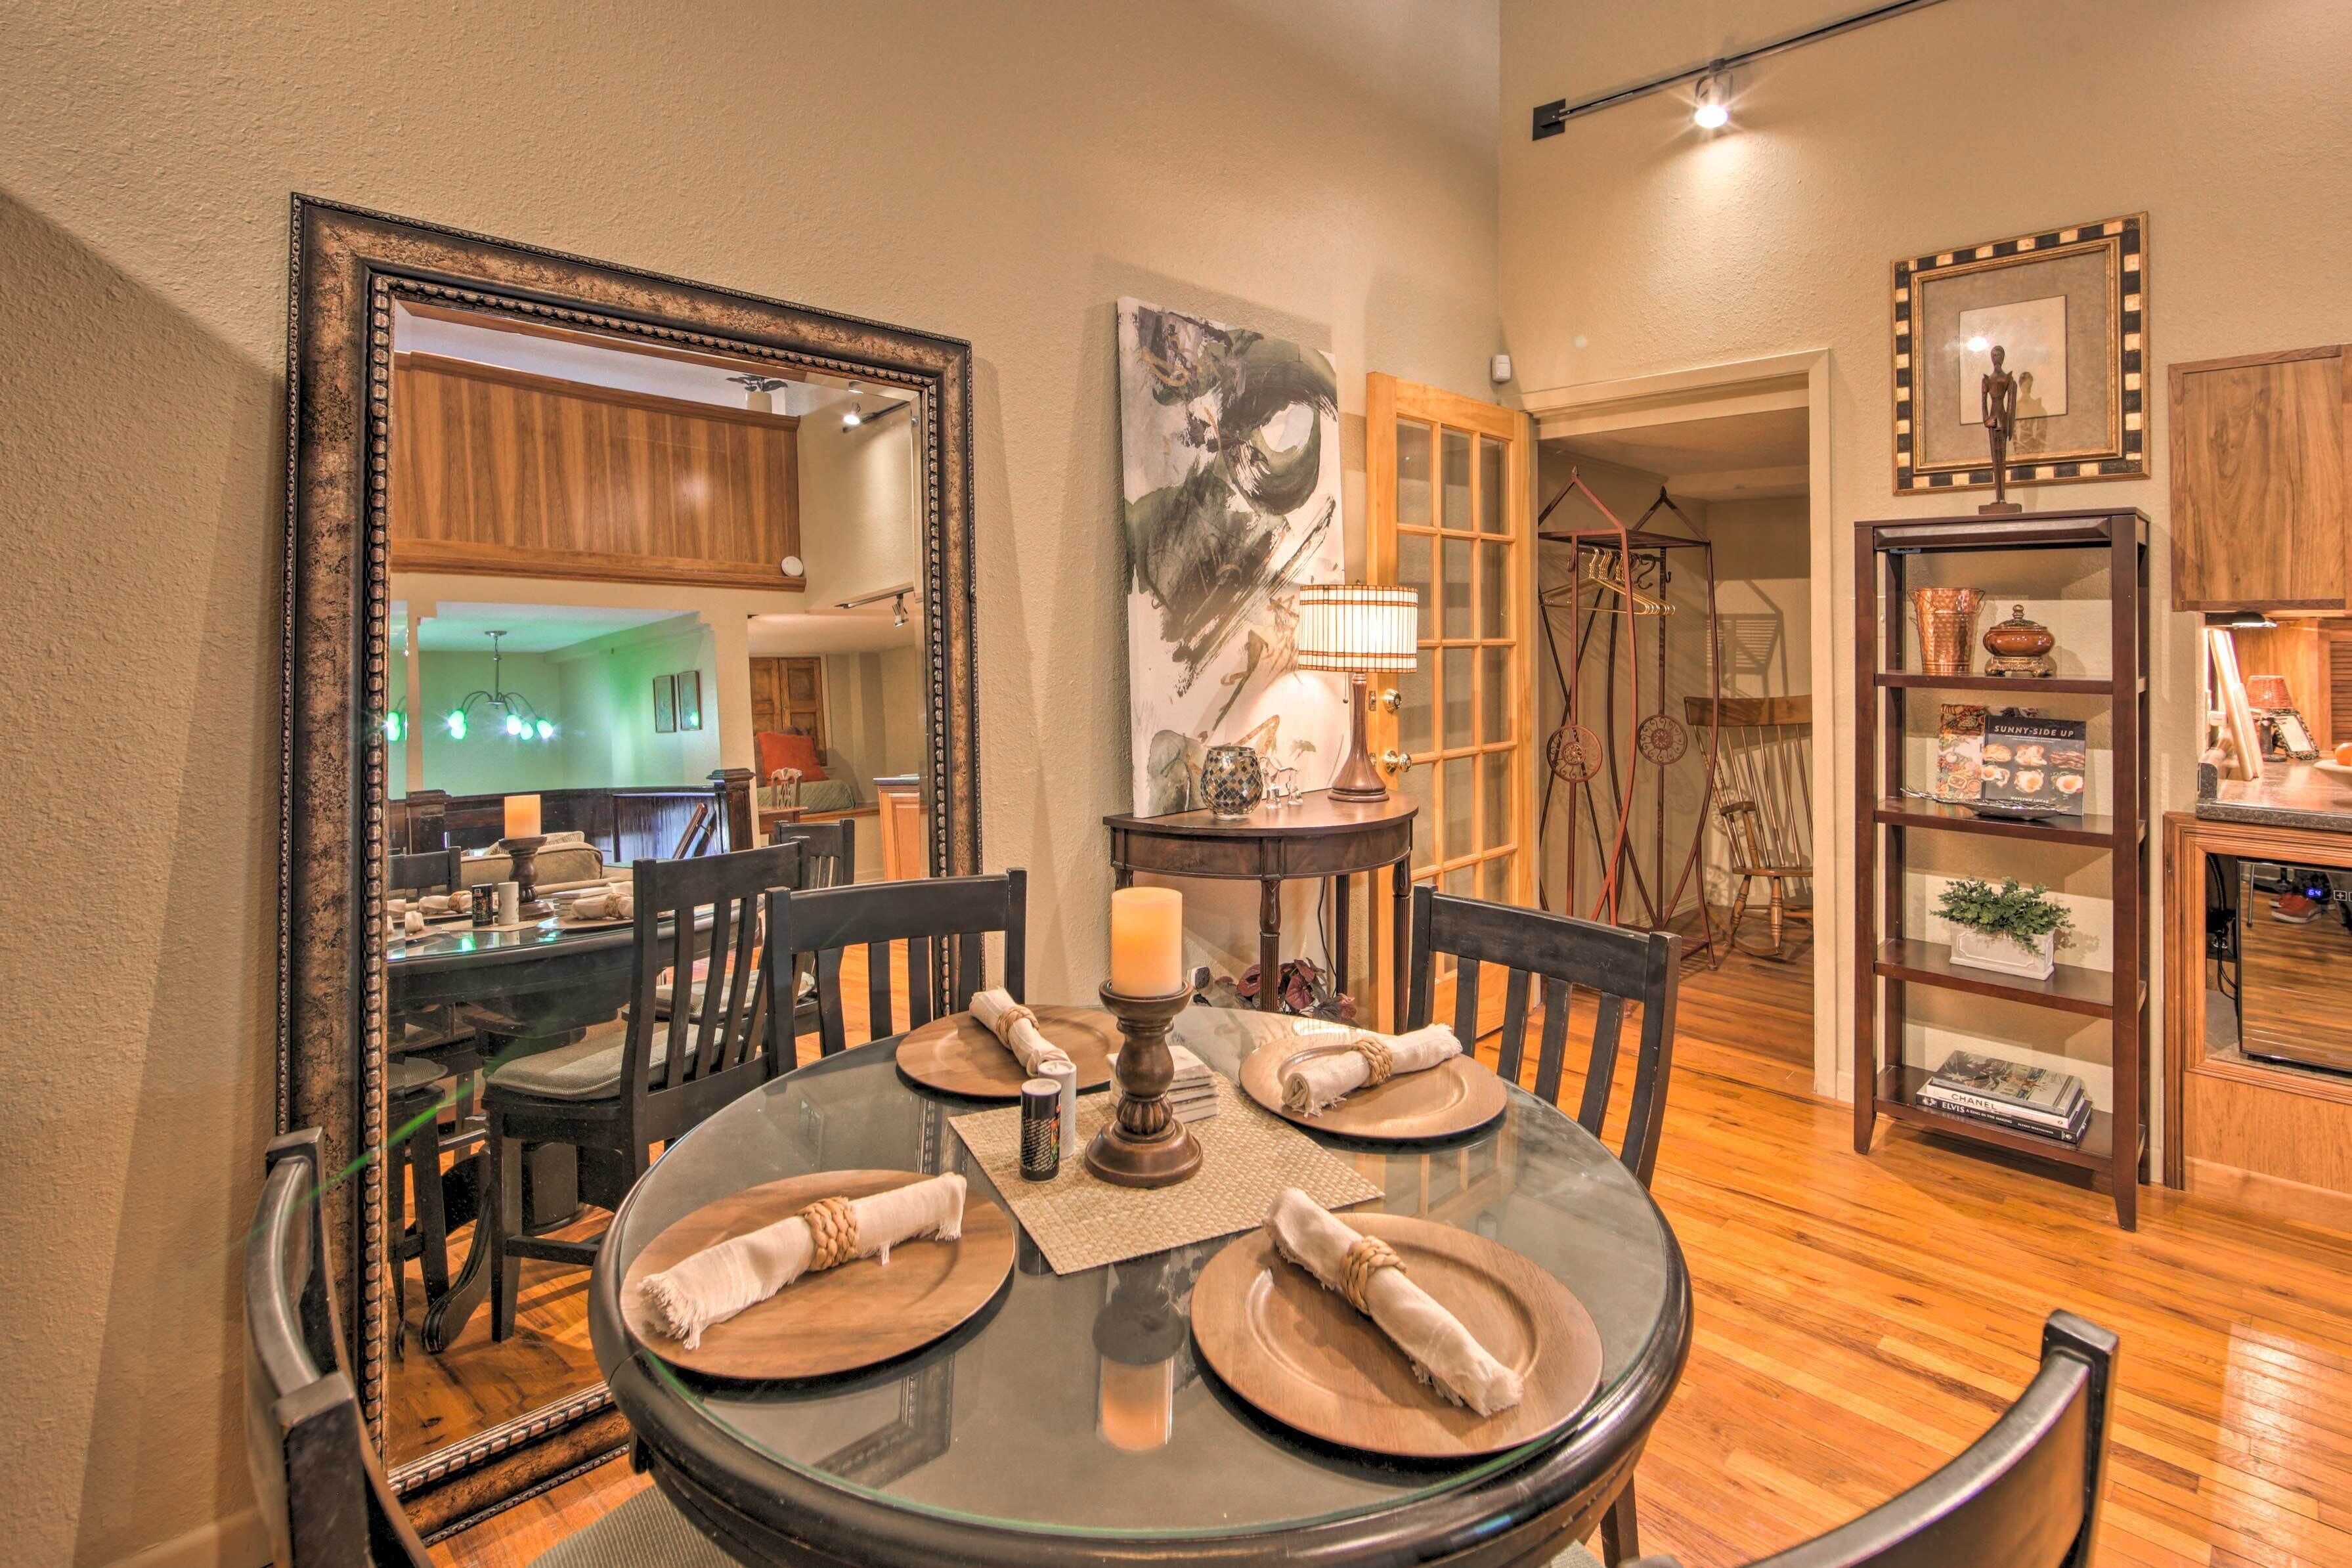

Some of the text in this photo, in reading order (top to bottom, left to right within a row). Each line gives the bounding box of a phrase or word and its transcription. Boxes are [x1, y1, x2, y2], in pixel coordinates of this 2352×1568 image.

[1994, 725, 2057, 736] SUNNY-SIDE
[1951, 1093, 1997, 1110] CHANEL
[1942, 1102, 1965, 1113] ELVIS
